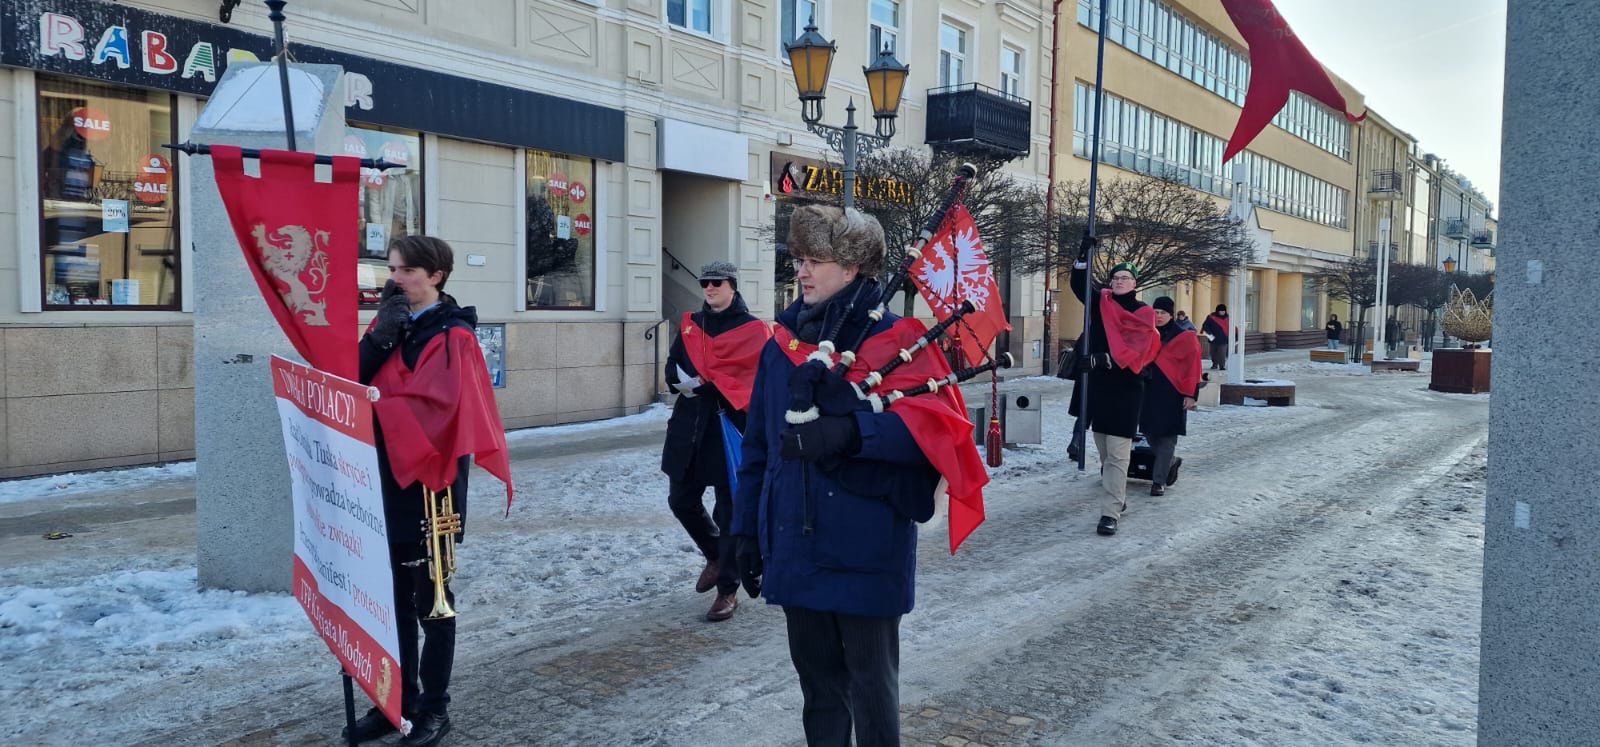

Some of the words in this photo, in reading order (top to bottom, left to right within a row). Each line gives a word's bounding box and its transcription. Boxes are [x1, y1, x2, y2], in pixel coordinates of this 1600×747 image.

[39, 11, 374, 110] RABAR
[74, 116, 111, 131] SALE
[134, 181, 168, 195] SALE
[548, 179, 567, 190] SALE
[805, 164, 862, 198] ZAHR
[574, 219, 592, 230] SALE
[307, 380, 356, 428] POLACY!
[313, 440, 338, 470] Tuska
[300, 578, 312, 607] TFP
[338, 623, 372, 684] Młodych
